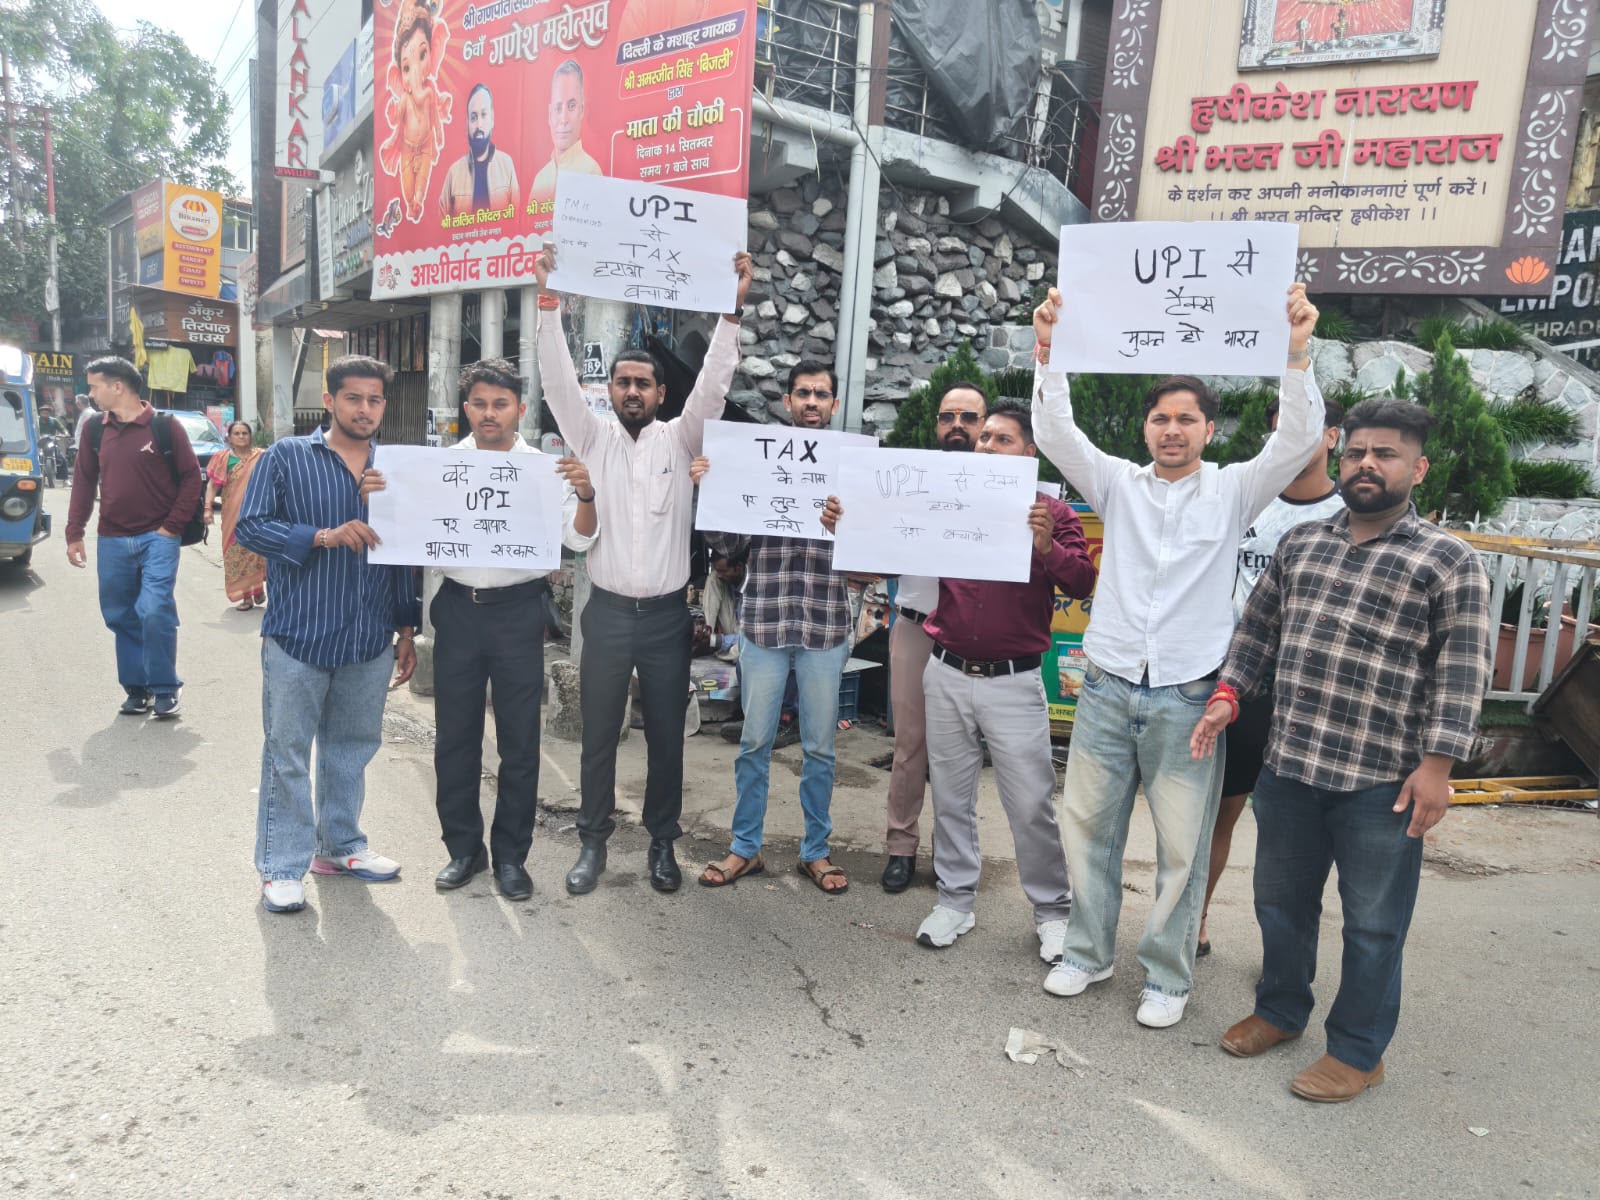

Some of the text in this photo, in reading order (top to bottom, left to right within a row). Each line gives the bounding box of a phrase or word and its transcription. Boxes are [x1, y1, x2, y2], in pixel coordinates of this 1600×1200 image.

[489, 20, 540, 65] गणेश
[542, 1, 611, 50] महोत्सव
[623, 19, 738, 60] दिल्ली के मशहूर गायक
[624, 71, 635, 90] श्री
[676, 58, 694, 79] सिंह
[626, 97, 726, 139] माता की चौकी
[1190, 80, 1479, 133] हृषीकेश नारायण
[665, 143, 675, 155] 14
[1155, 129, 1504, 173] श्री भरत जी महाराज
[640, 165, 661, 178] समय
[665, 164, 670, 175] 7
[673, 157, 688, 173] बजे
[1168, 184, 1183, 201] के
[1187, 183, 1223, 202] दर्शन
[1228, 188, 1252, 201] कर
[1257, 181, 1303, 200] अपनी
[1307, 179, 1407, 199] मनोकामनाएं
[1413, 177, 1443, 202] पूर्ण
[502, 203, 515, 220] जी
[526, 199, 538, 215] श्री
[629, 194, 697, 223] UPI
[1230, 206, 1248, 221] श्री
[1254, 210, 1289, 223] भरत
[1294, 204, 1343, 224] मन्दिर
[1350, 203, 1411, 226] हृषीकेश
[640, 223, 670, 242] से
[618, 242, 682, 265] TAX
[1134, 238, 1259, 284] UPI से
[410, 249, 482, 287] आशीर्वाद
[181, 317, 231, 335] तिरपाल
[188, 332, 226, 344] हाउस
[1118, 322, 1259, 357] मुक्त हो भारत
[754, 438, 818, 464] TAX
[442, 460, 523, 488] बंद करो
[771, 465, 828, 485] के नाम
[875, 464, 930, 498] UPI
[466, 487, 511, 511] UPI
[742, 494, 758, 508] पर
[432, 517, 460, 534] पर
[763, 514, 804, 534] करो
[425, 541, 540, 561] भाजपा सरकार
